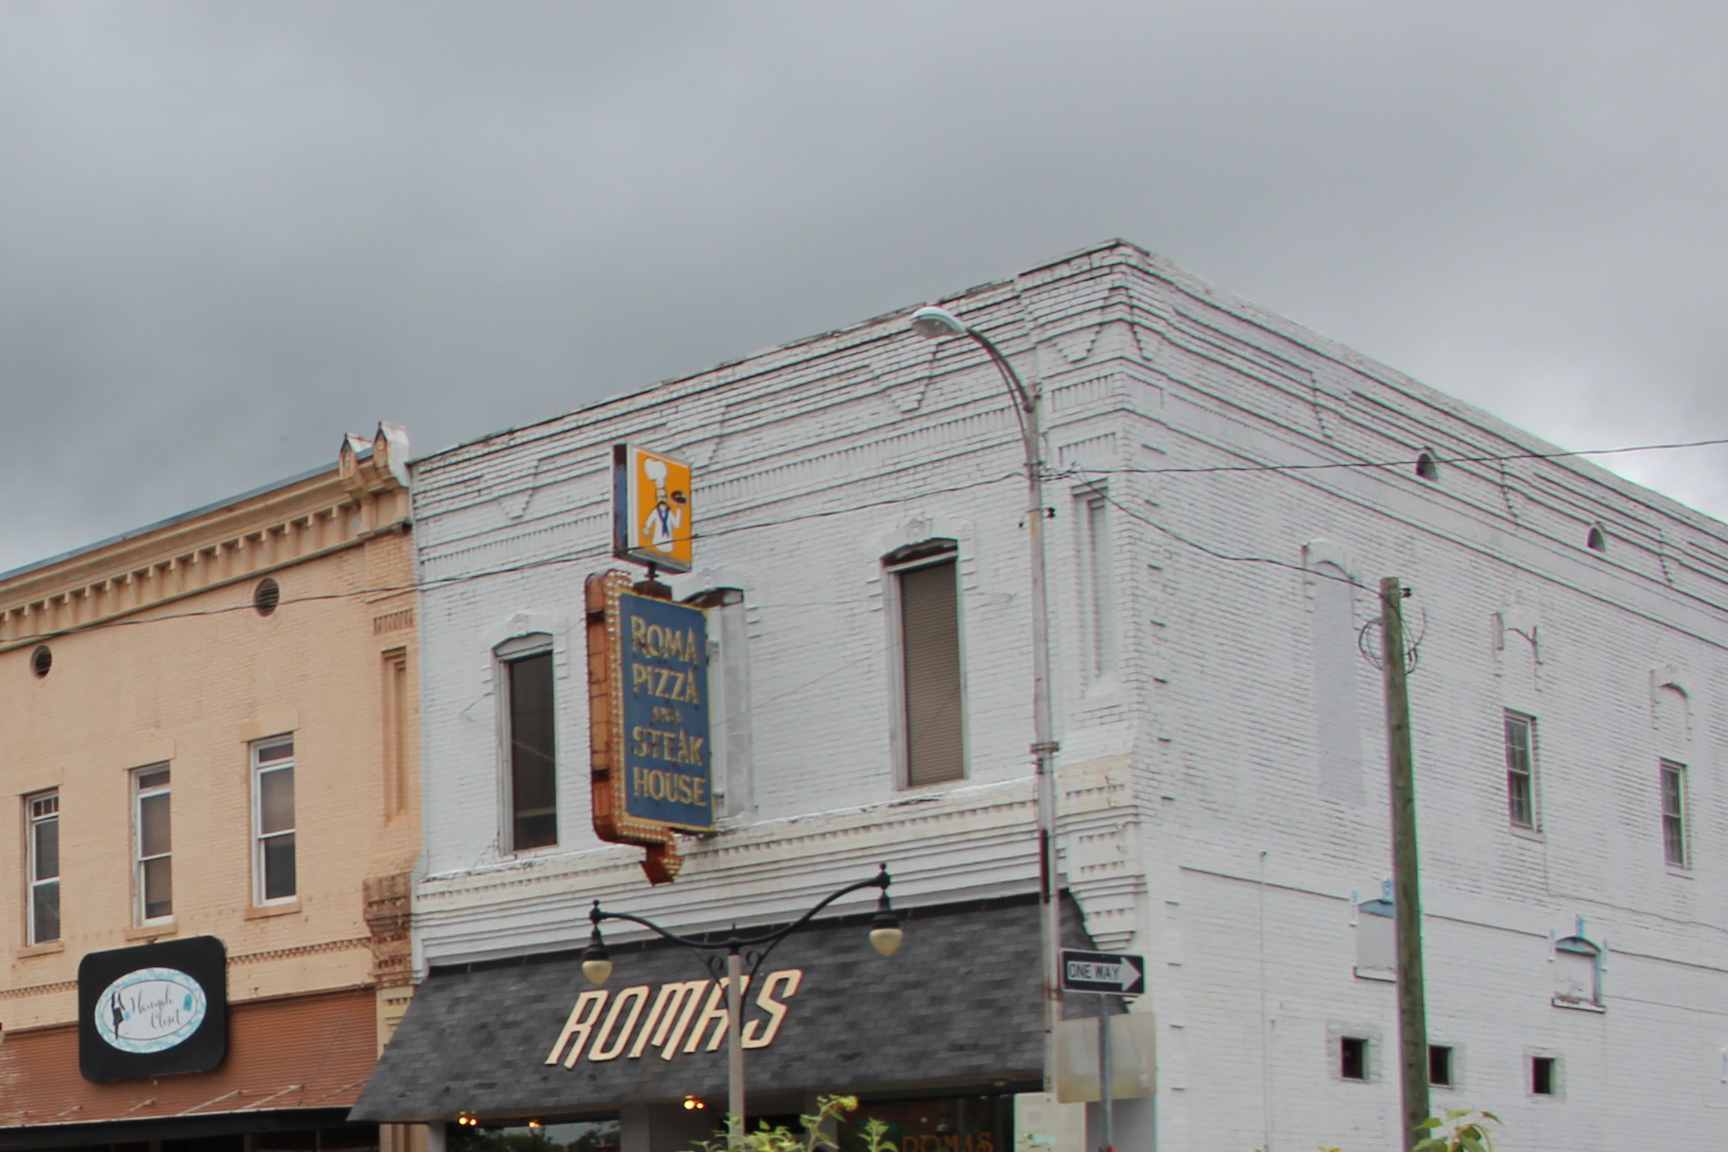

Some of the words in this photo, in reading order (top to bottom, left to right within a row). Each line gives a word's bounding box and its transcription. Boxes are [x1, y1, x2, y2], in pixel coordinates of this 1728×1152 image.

[630, 614, 699, 665] ROMA
[631, 662, 699, 704] PIZZA
[652, 706, 683, 725] AND
[632, 725, 704, 766] STEAK
[633, 766, 708, 807] HOUSE
[1068, 963, 1091, 979] ONE
[1094, 965, 1119, 981] WAY
[544, 969, 803, 1069] ROMAS
